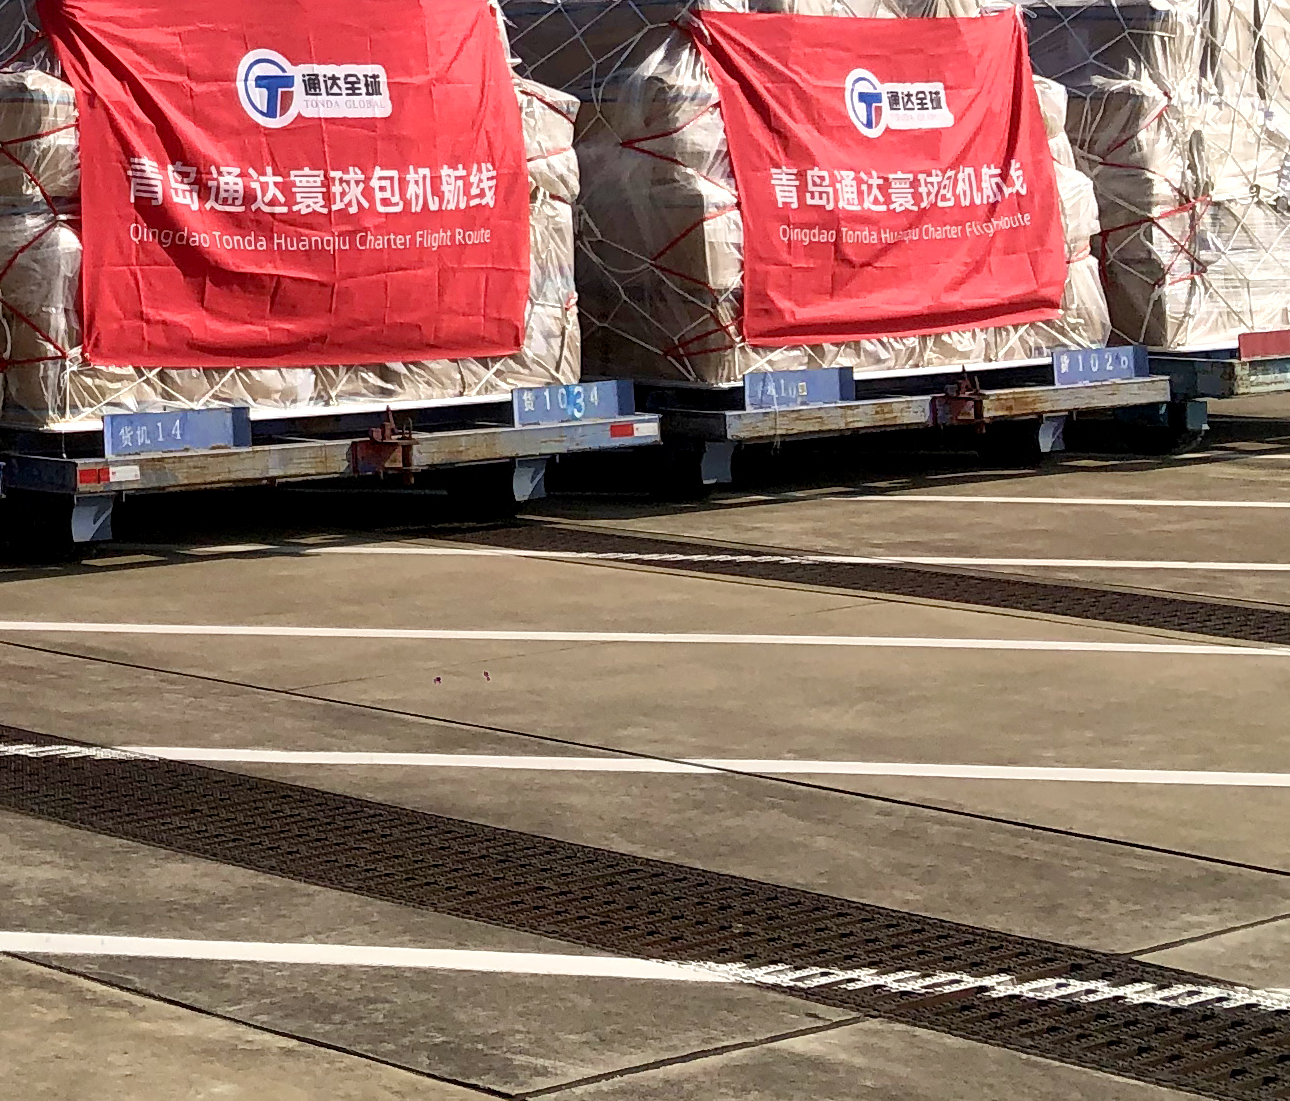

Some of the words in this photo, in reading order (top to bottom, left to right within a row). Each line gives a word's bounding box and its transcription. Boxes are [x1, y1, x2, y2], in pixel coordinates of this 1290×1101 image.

[301, 73, 383, 97] 通达全球
[303, 99, 341, 109] TONDA
[127, 156, 497, 215] 青岛通达寰球包机航线
[129, 223, 210, 248] Qingdao
[212, 231, 267, 250] Tonda
[274, 232, 350, 254] Huanqiu
[356, 231, 412, 250] Charter
[416, 228, 452, 251] Flight
[455, 227, 491, 245] Route
[780, 225, 836, 245] Qingdao
[841, 227, 878, 243] Tonda
[922, 223, 962, 240] Charter
[543, 385, 600, 419] 1034
[119, 425, 151, 447] 货机
[156, 419, 182, 442] 14
